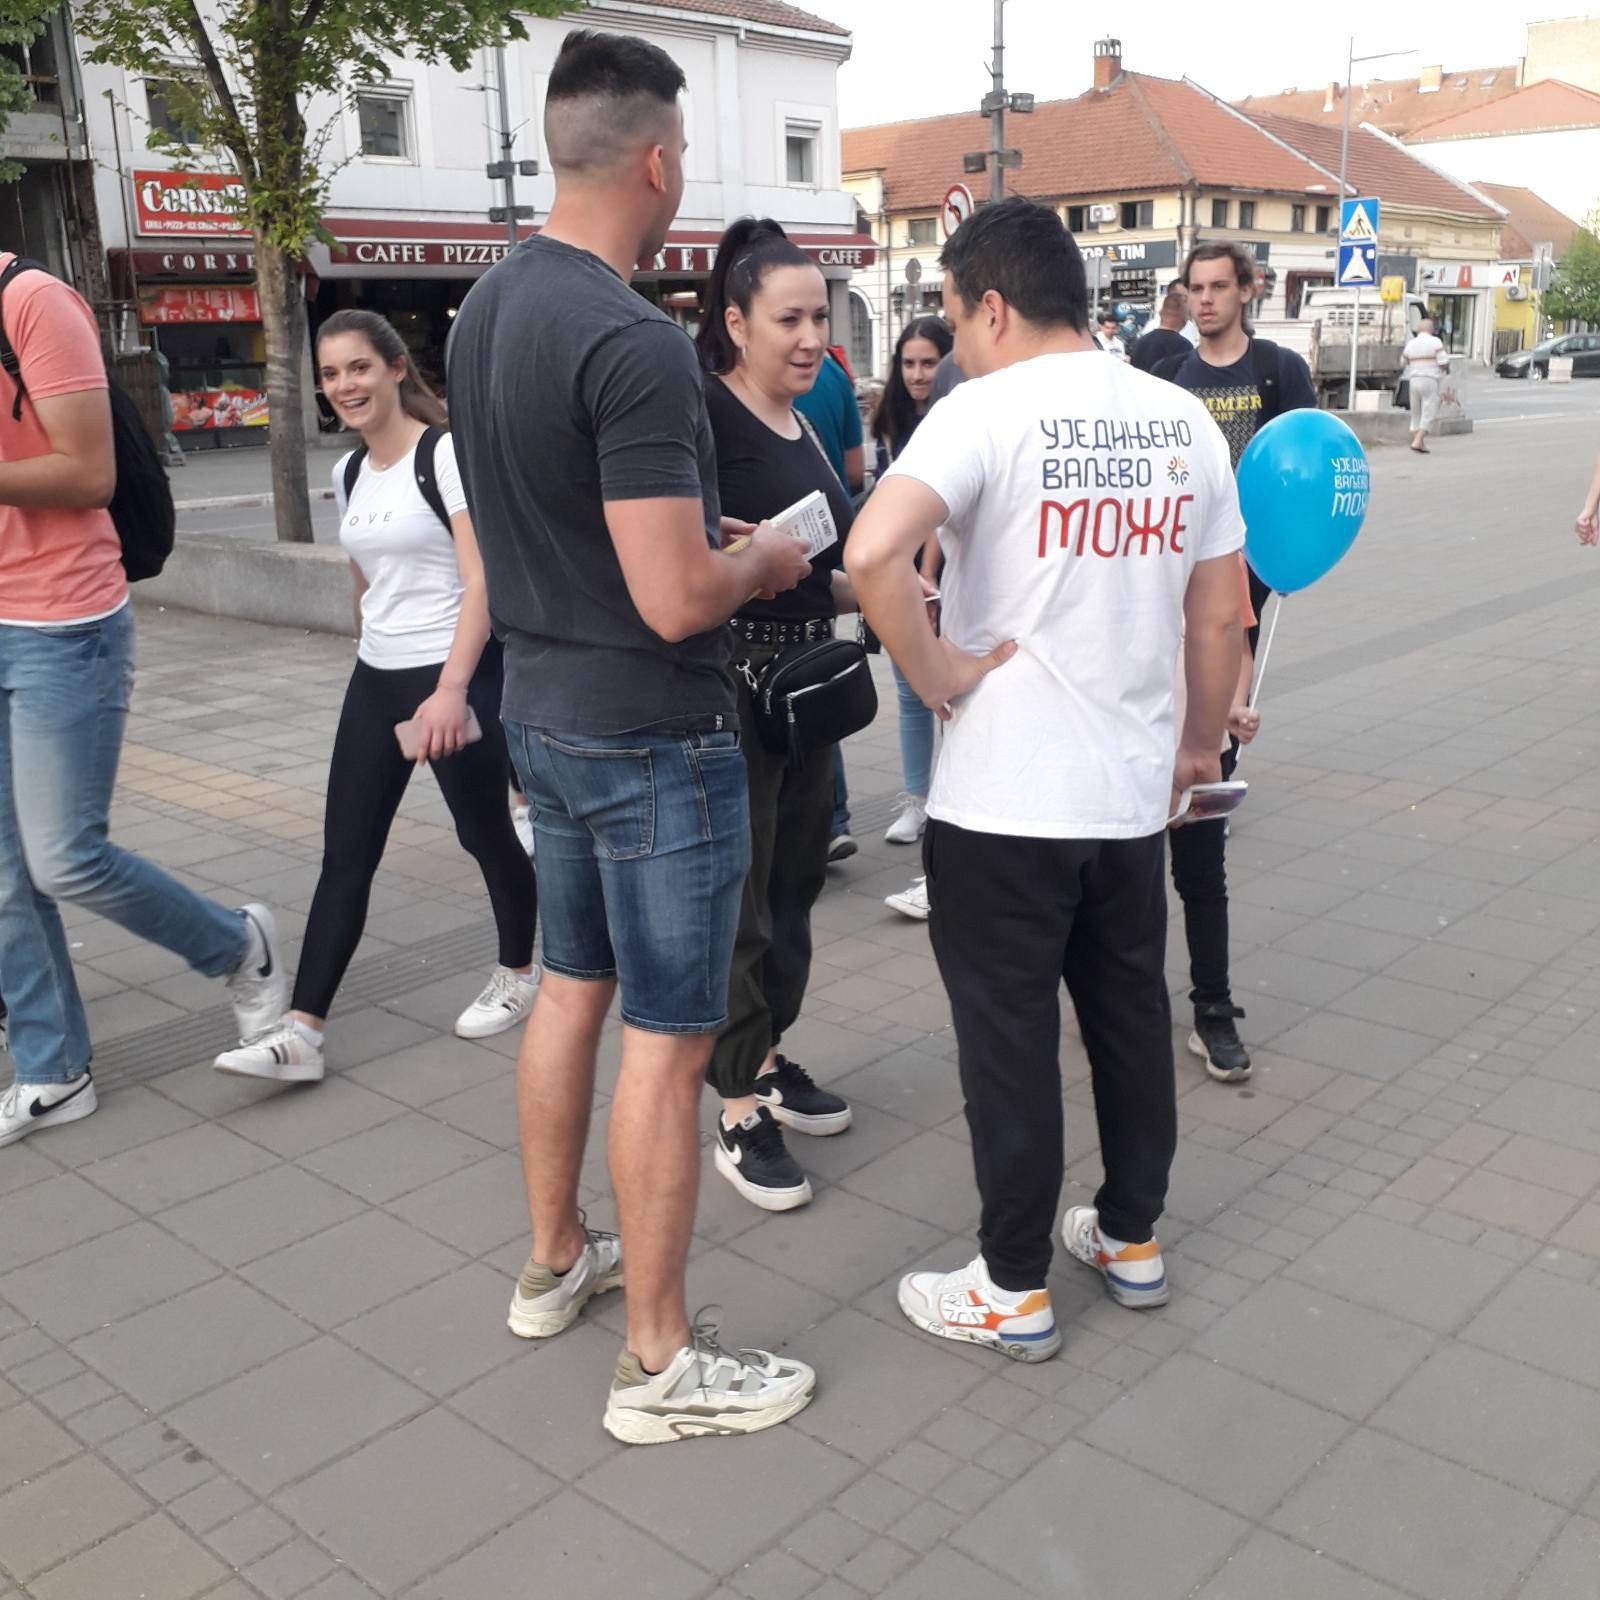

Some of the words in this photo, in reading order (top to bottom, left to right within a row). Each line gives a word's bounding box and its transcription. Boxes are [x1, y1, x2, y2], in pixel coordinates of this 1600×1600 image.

[355, 244, 426, 264] CAFFE
[818, 249, 863, 266] CAFFE
[1119, 243, 1146, 260] TIM
[1040, 418, 1192, 452] УЈЕДИЊЕНО
[1042, 457, 1151, 490] ВАЉЕВО
[1038, 494, 1194, 558] МОЖЕ
